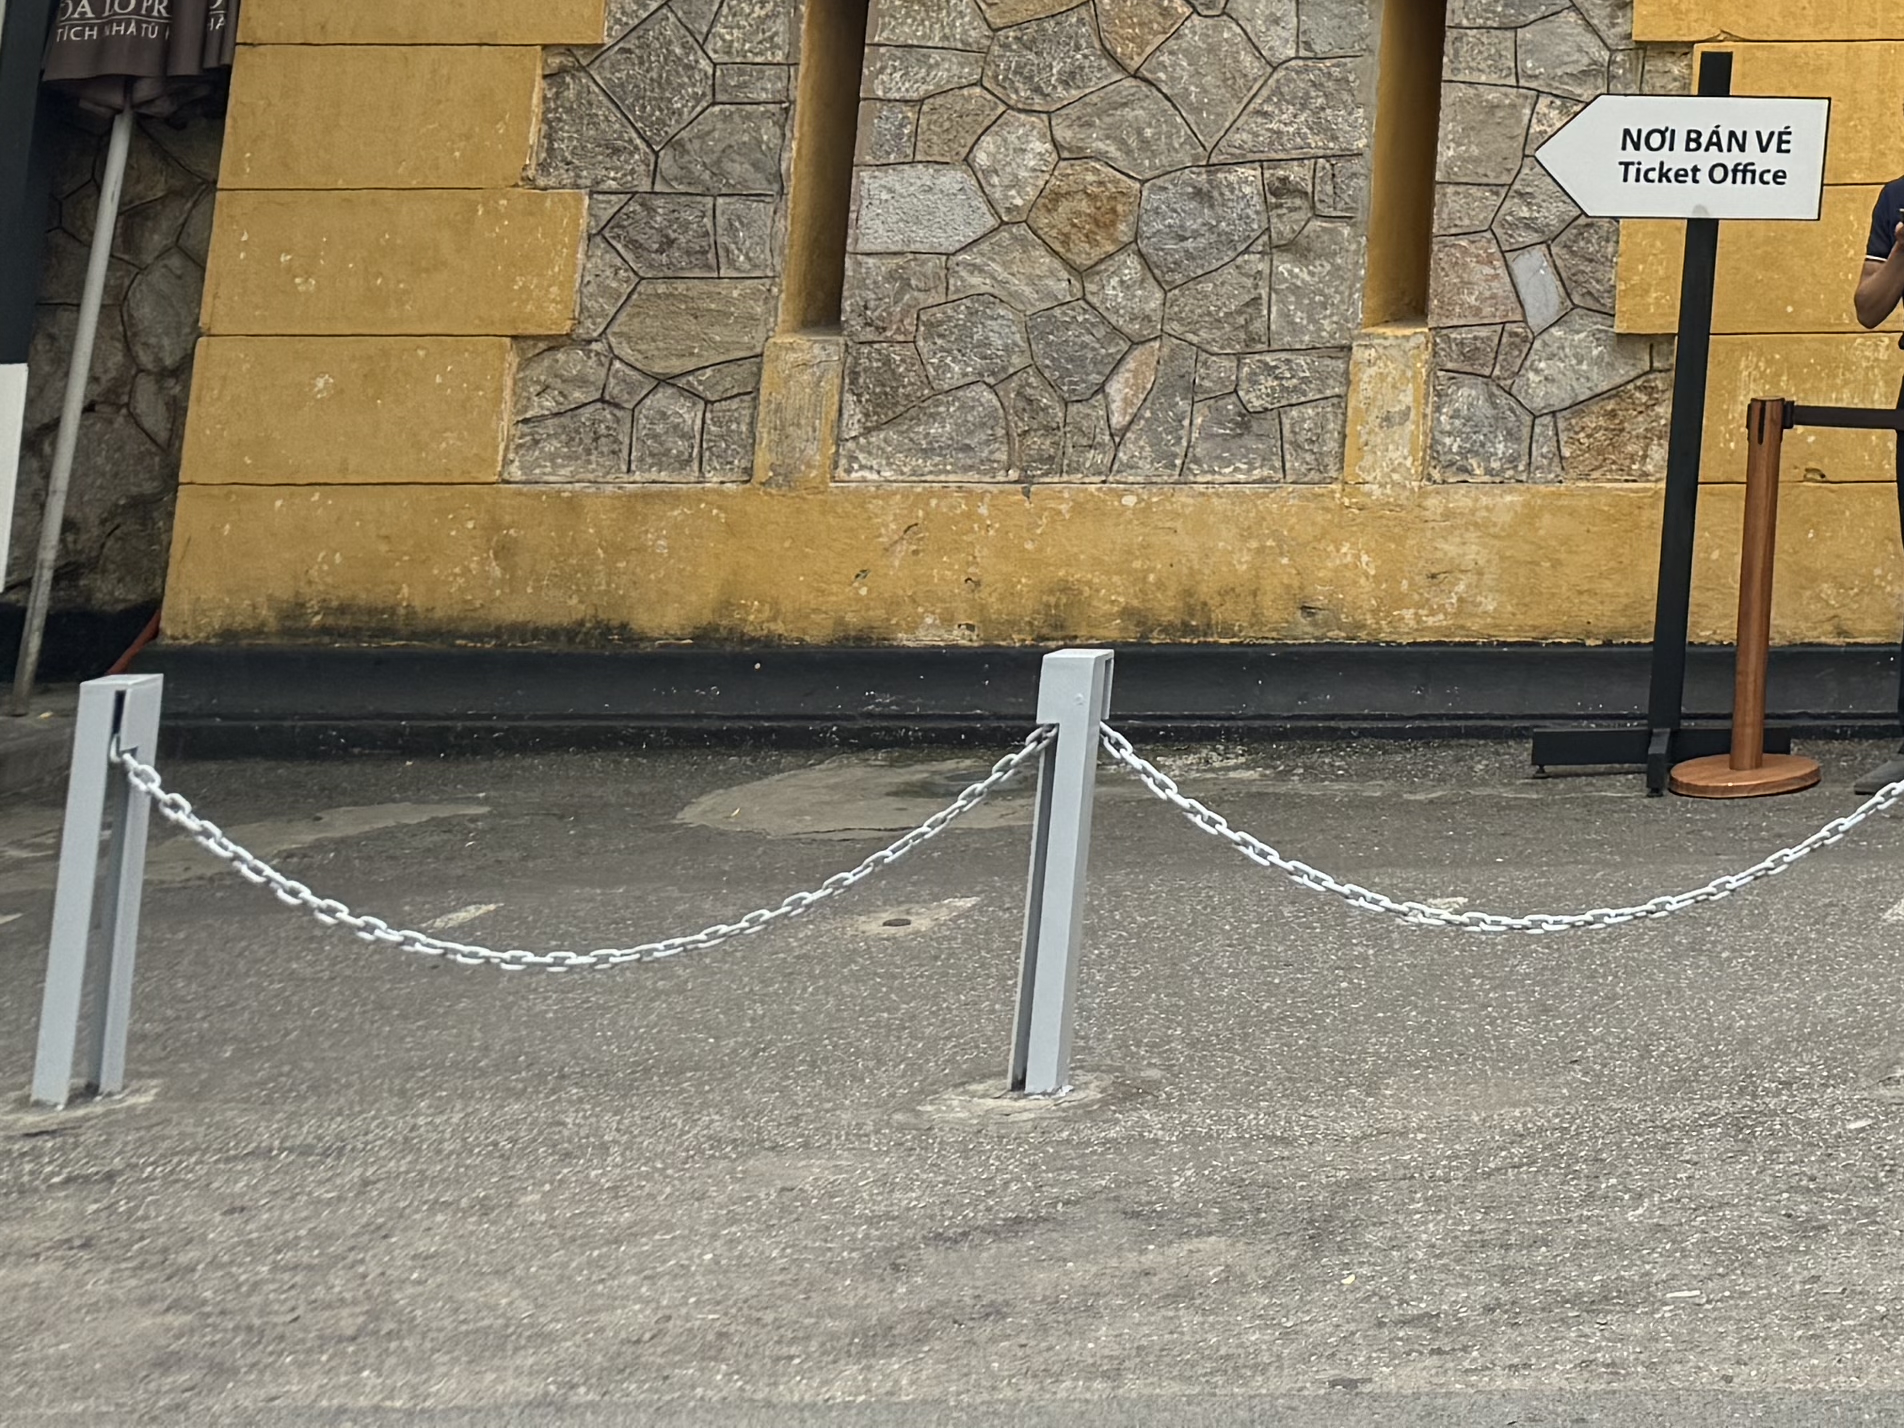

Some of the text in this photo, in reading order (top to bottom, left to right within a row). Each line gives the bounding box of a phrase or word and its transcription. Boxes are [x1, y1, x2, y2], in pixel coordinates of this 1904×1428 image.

[1620, 124, 1793, 154] NƠI BÁN VÉ
[1618, 160, 1788, 187] Ticket Office
